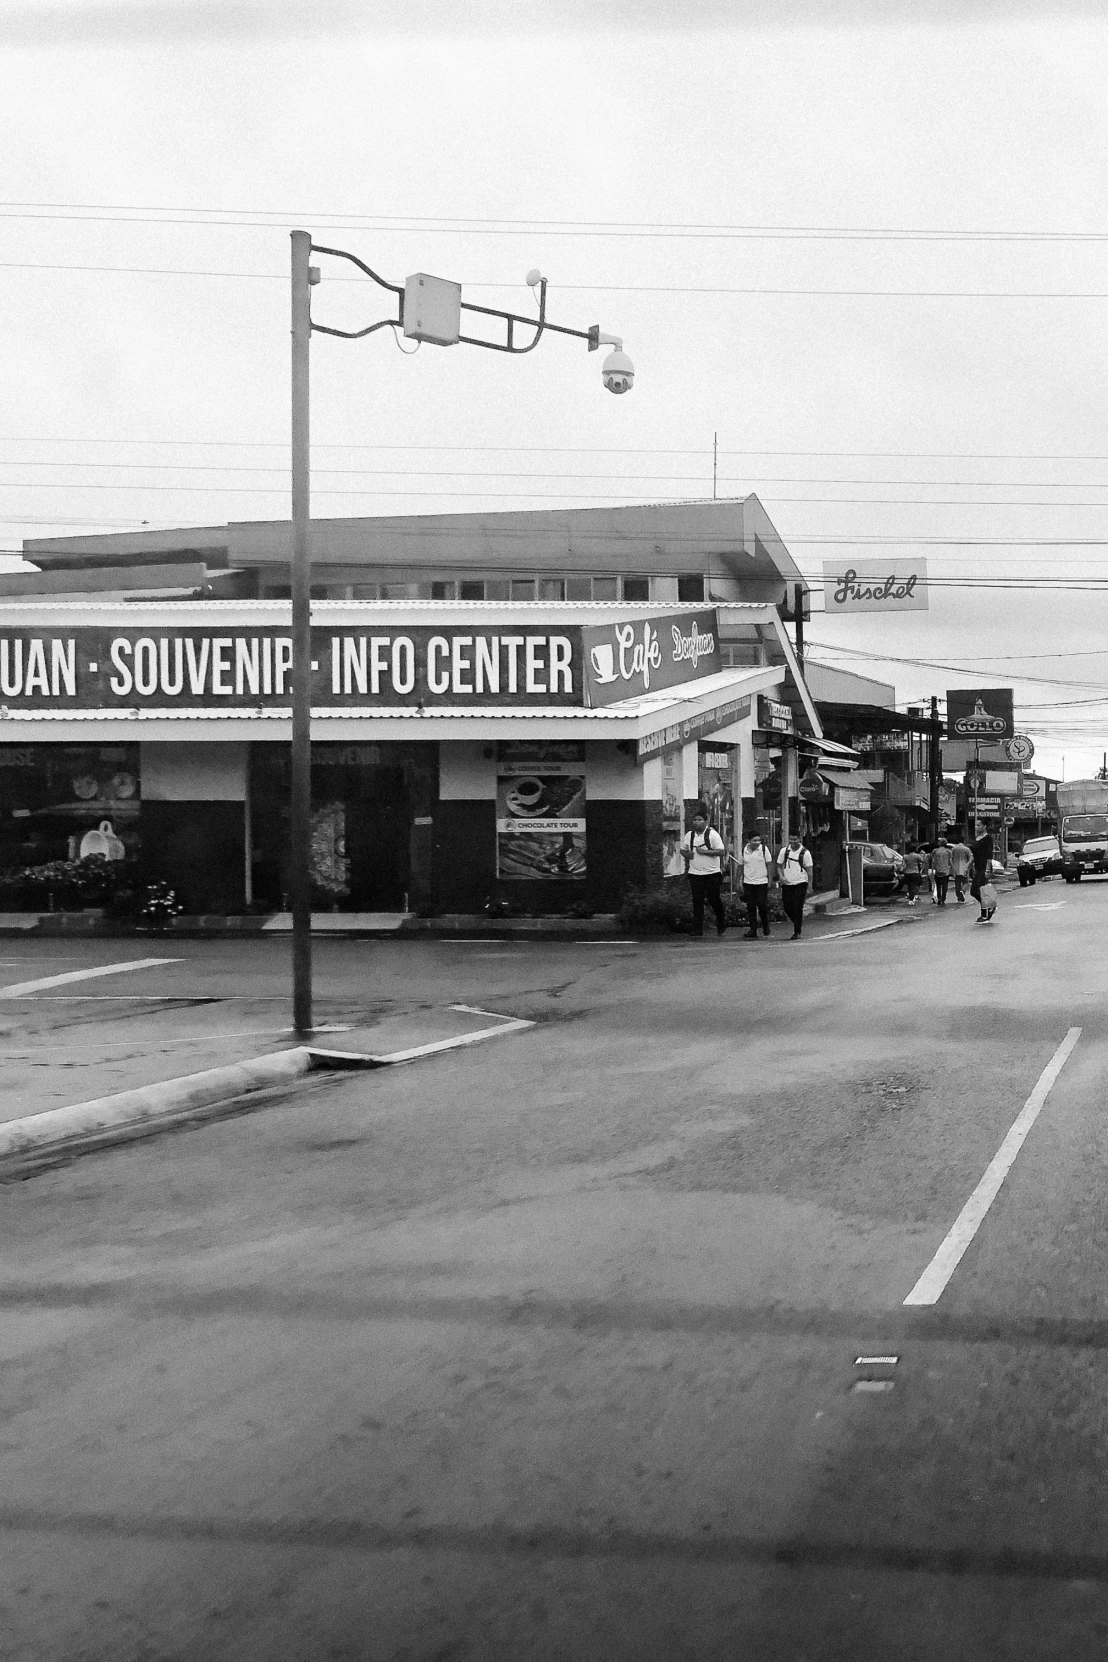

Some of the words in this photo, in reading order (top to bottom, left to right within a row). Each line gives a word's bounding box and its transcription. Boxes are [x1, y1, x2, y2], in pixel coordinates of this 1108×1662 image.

[834, 569, 917, 604] Fischel
[331, 636, 415, 695] INFO
[427, 636, 573, 694] CENTER
[615, 621, 662, 690] Café
